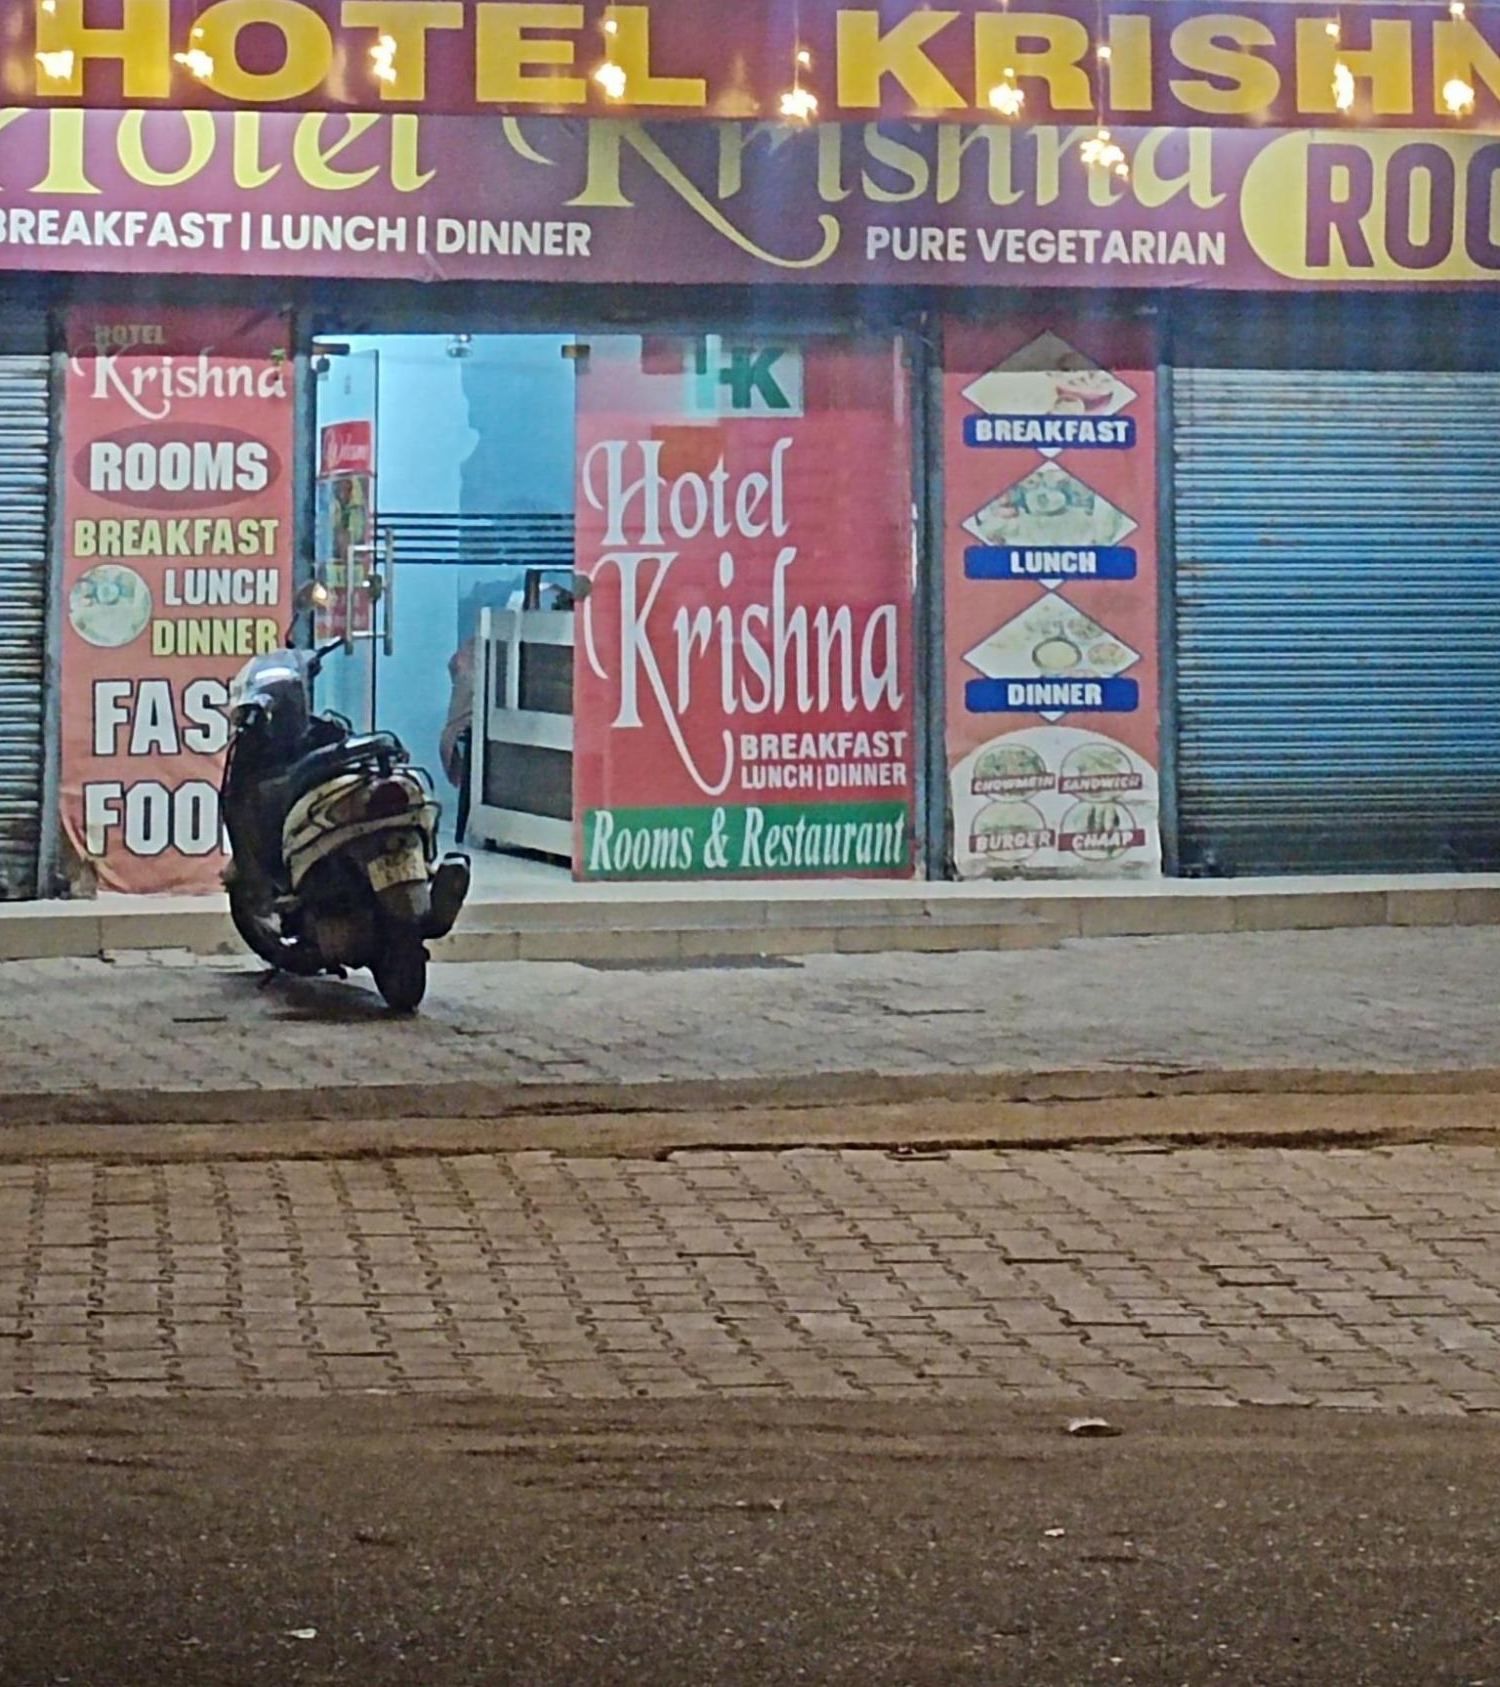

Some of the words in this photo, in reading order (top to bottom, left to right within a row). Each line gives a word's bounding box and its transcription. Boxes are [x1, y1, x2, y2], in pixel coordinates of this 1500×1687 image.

[260, 215, 397, 254] LUNCH
[437, 219, 591, 258] DINNER
[866, 228, 966, 264] PURE
[977, 228, 1226, 267] VEGETARIAN
[72, 342, 288, 421] Krishna
[975, 419, 1129, 443] BREAKFAST
[90, 442, 269, 492] ROOMS
[583, 437, 794, 546] Hotel
[74, 519, 279, 558] BREAKFAST
[1010, 551, 1097, 575] LUNCH
[164, 568, 279, 606] LUNCH
[152, 618, 280, 657] DINNER
[583, 547, 904, 796] Krishna
[1007, 683, 1103, 707] DINNER
[93, 679, 232, 756] FAS
[740, 731, 907, 761] BREAKFAST
[84, 780, 232, 857] FOO
[589, 809, 693, 873] Rooms
[703, 807, 728, 869] &
[741, 807, 906, 868] Restaurant
[975, 831, 1052, 852] BURGER
[1071, 831, 1135, 852] CHAAP
